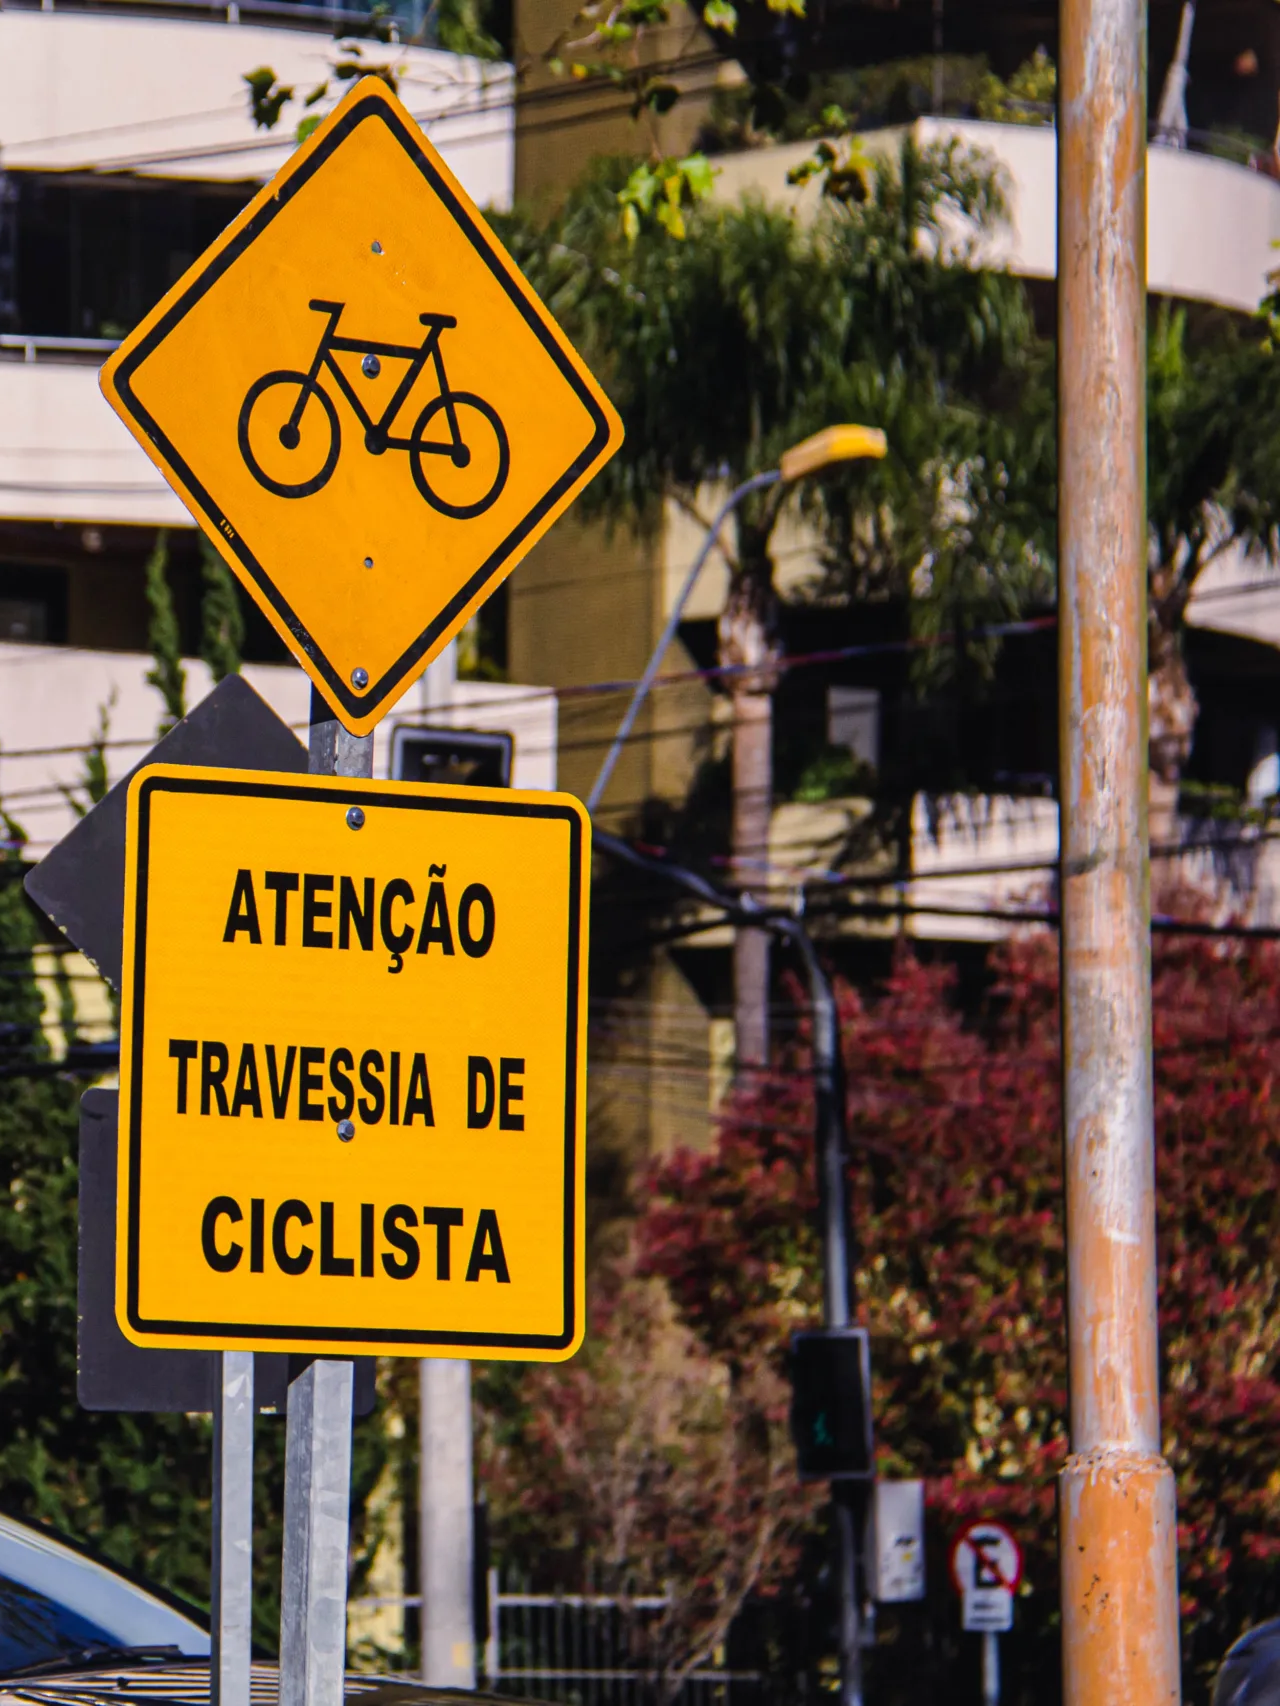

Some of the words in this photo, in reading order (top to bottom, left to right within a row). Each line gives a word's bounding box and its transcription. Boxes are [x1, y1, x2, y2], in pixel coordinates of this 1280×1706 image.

[223, 863, 495, 974] ATENÇÃO
[169, 1039, 435, 1128] TRAVESSIA
[468, 1055, 525, 1131] DE
[201, 1195, 511, 1284] CICLISTA
